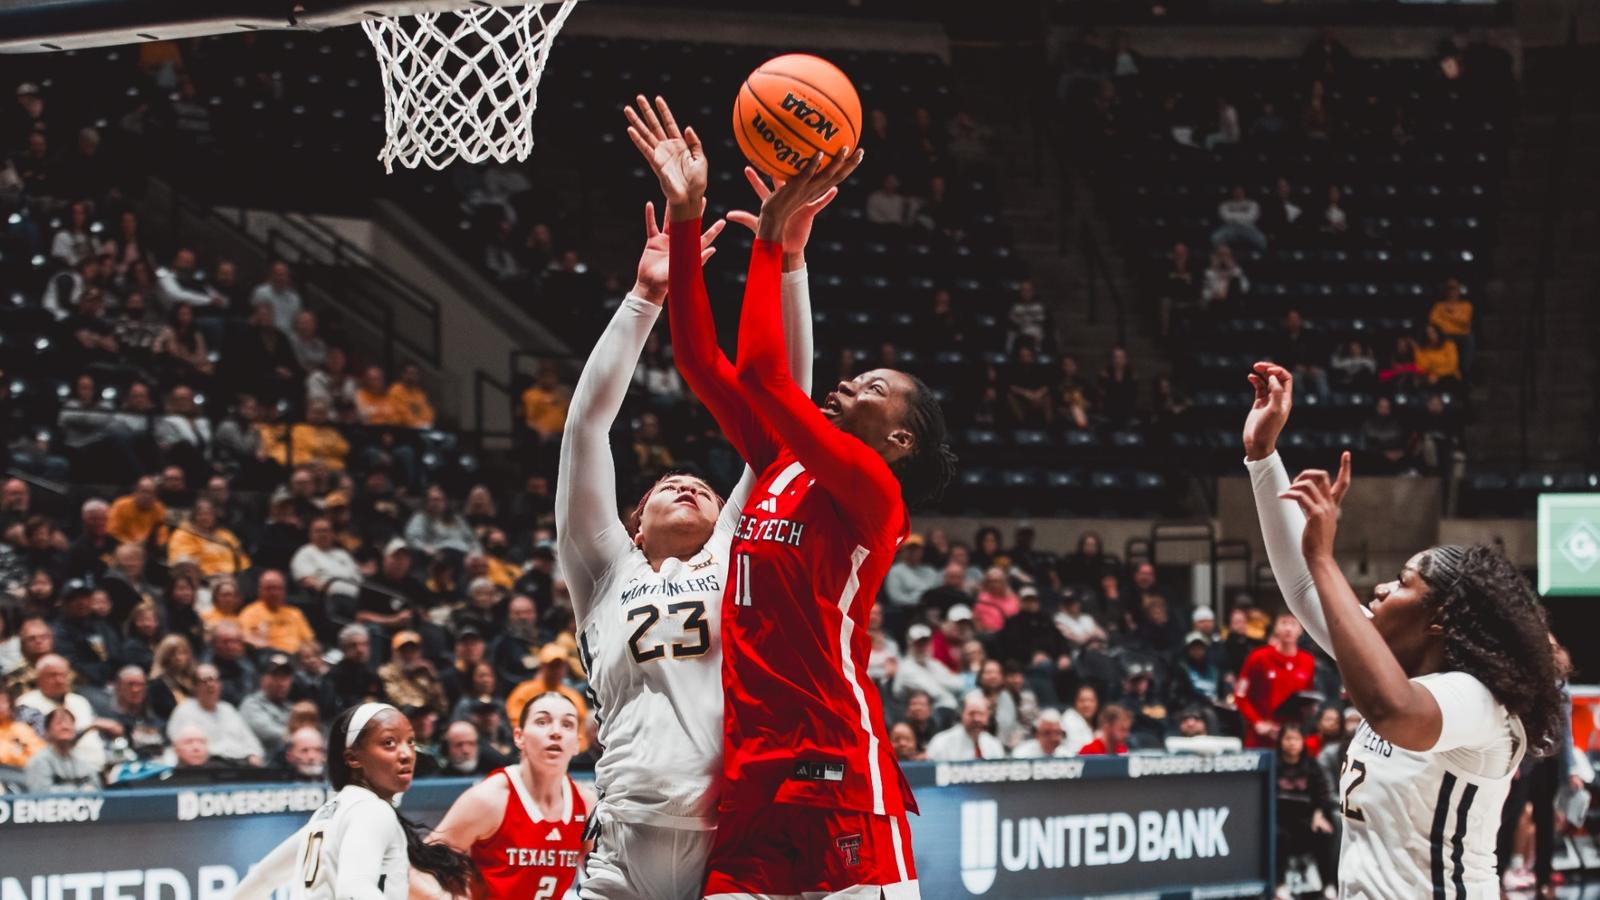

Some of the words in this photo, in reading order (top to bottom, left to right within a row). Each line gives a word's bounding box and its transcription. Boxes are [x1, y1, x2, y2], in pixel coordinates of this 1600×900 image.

[780, 92, 840, 142] NCAA
[753, 518, 804, 546] TECH
[734, 553, 752, 606] 11
[626, 600, 711, 663] 23
[13, 798, 104, 823] ENERGY
[199, 788, 326, 817] DIVERSIFIED
[1001, 812, 1137, 871] UNITED
[1138, 806, 1230, 862] BANK
[506, 847, 556, 866] TEXAS
[1, 868, 192, 900] NITED
